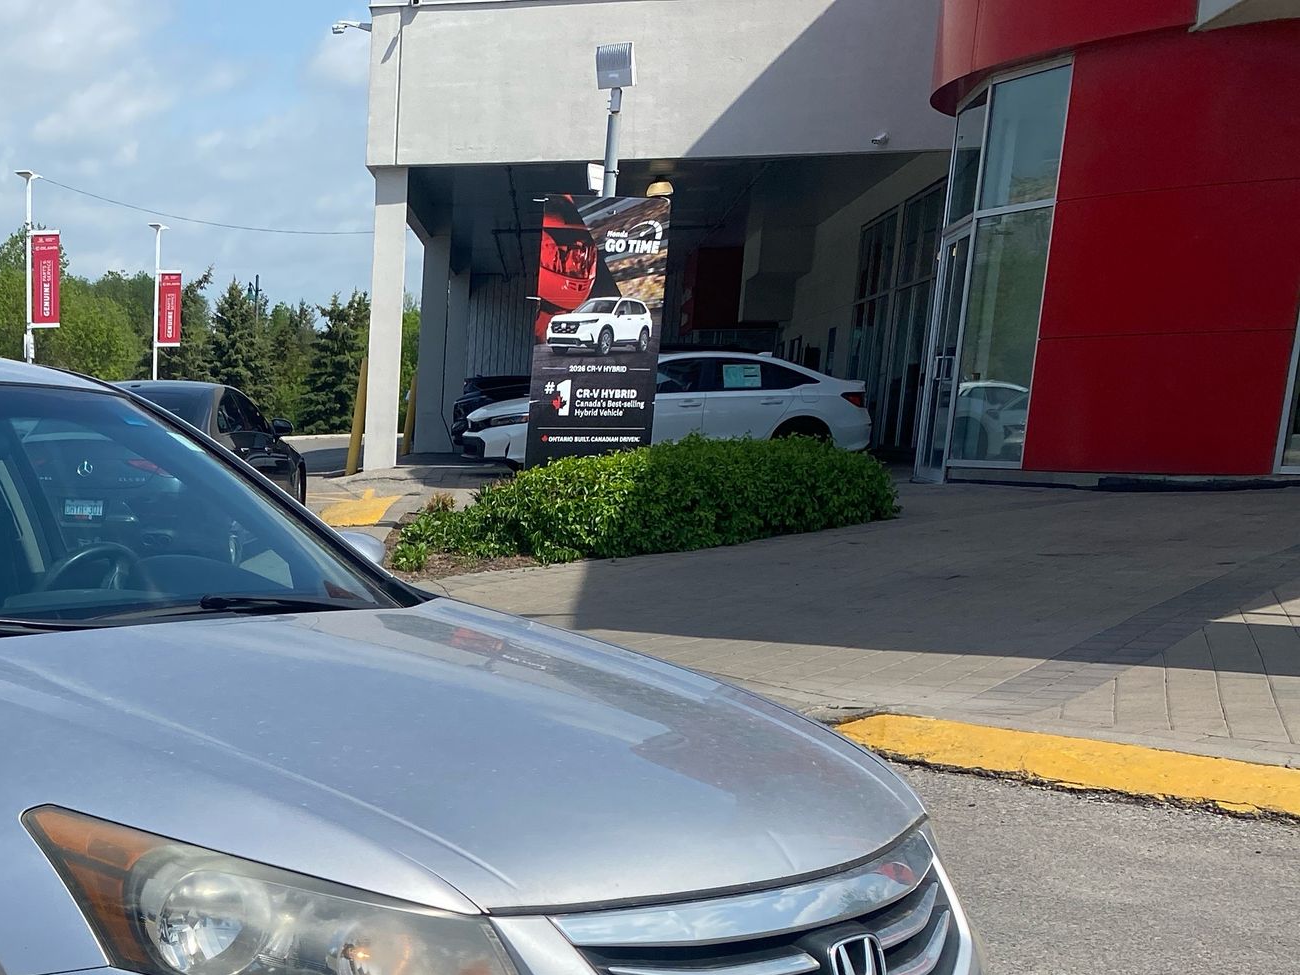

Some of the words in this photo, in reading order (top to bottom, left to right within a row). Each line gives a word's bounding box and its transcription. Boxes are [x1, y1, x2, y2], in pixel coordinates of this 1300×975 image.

[605, 239, 626, 253] GO
[628, 239, 661, 254] TIME
[586, 365, 603, 373] CR-V
[576, 388, 600, 399] CR-V
[601, 388, 638, 399] HYBRID
[575, 400, 606, 408] Canada's
[607, 400, 645, 410] Best-selling
[574, 409, 599, 418] Hybrid
